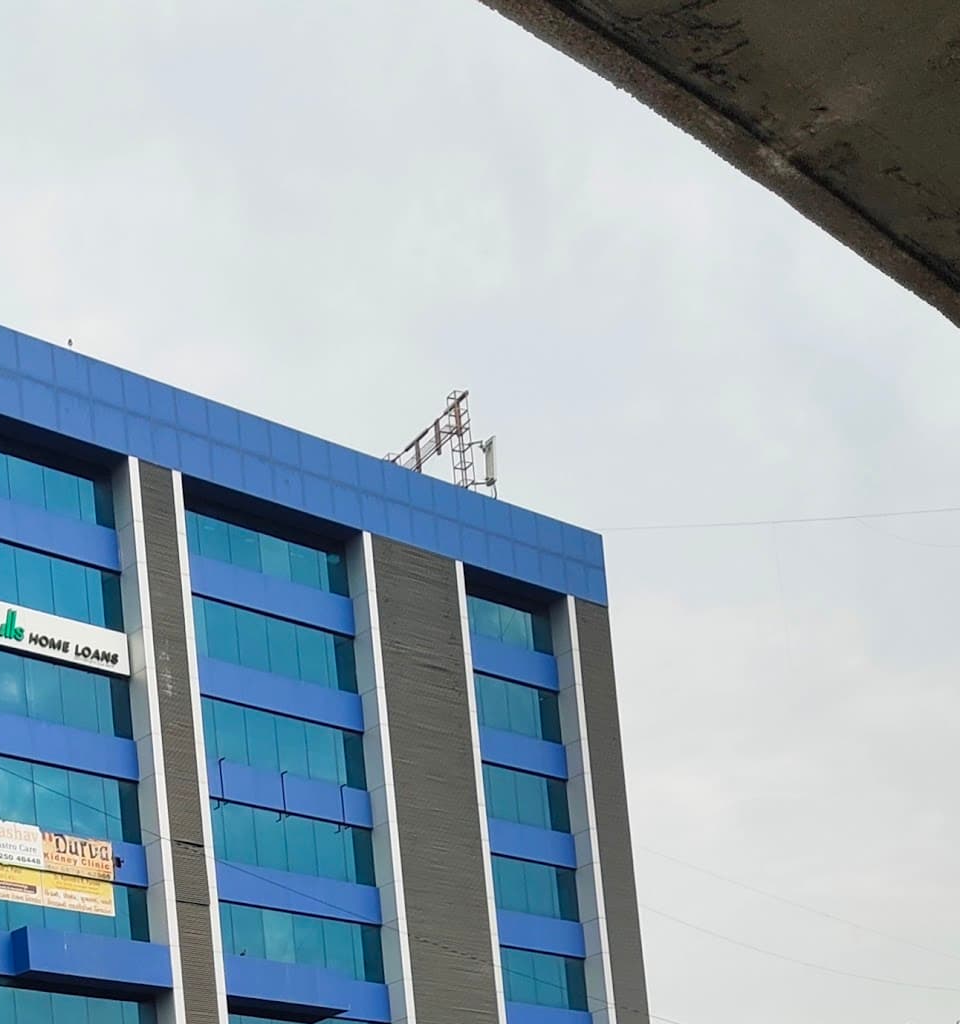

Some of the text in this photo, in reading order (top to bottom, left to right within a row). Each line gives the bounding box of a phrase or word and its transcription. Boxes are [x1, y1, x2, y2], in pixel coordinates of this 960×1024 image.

[28, 633, 70, 653] HOME
[75, 644, 119, 665] LOANS
[18, 845, 38, 854] Care
[43, 852, 112, 871] Kidney Clinic
